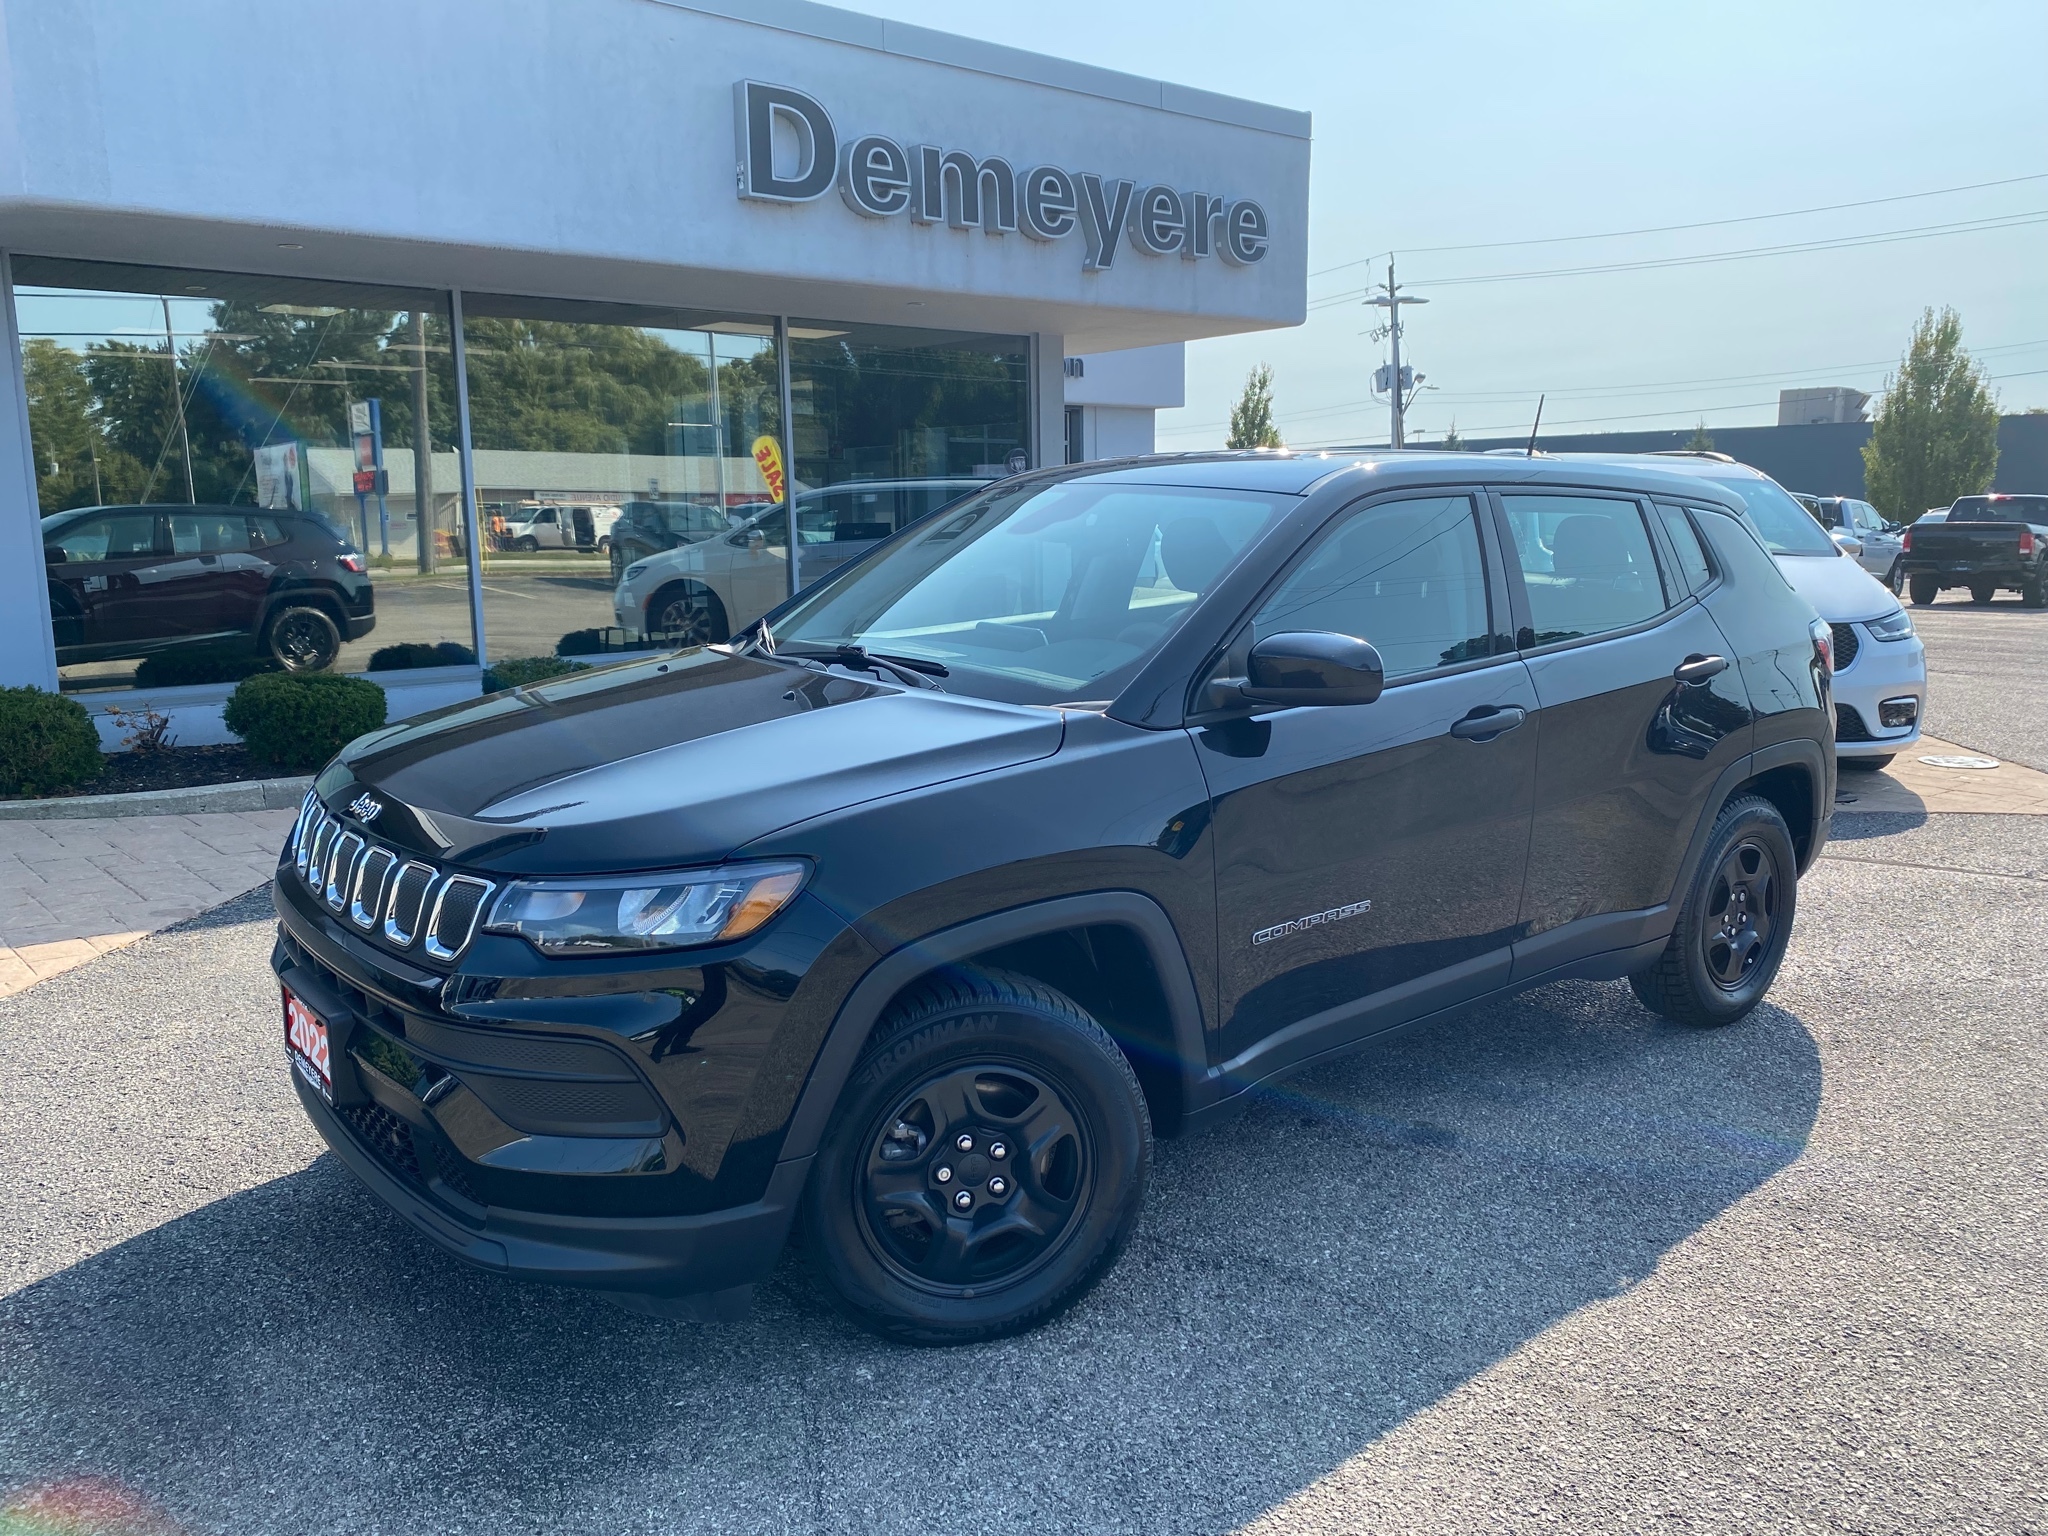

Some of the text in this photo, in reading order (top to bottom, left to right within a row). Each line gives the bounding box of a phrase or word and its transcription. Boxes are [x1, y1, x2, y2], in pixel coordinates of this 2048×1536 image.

[735, 79, 1270, 271] Demeyere
[349, 791, 383, 823] Jeep
[1252, 899, 1371, 946] COMPASS
[288, 1002, 332, 1082] 2022
[871, 1014, 999, 1081] IRONMAN
